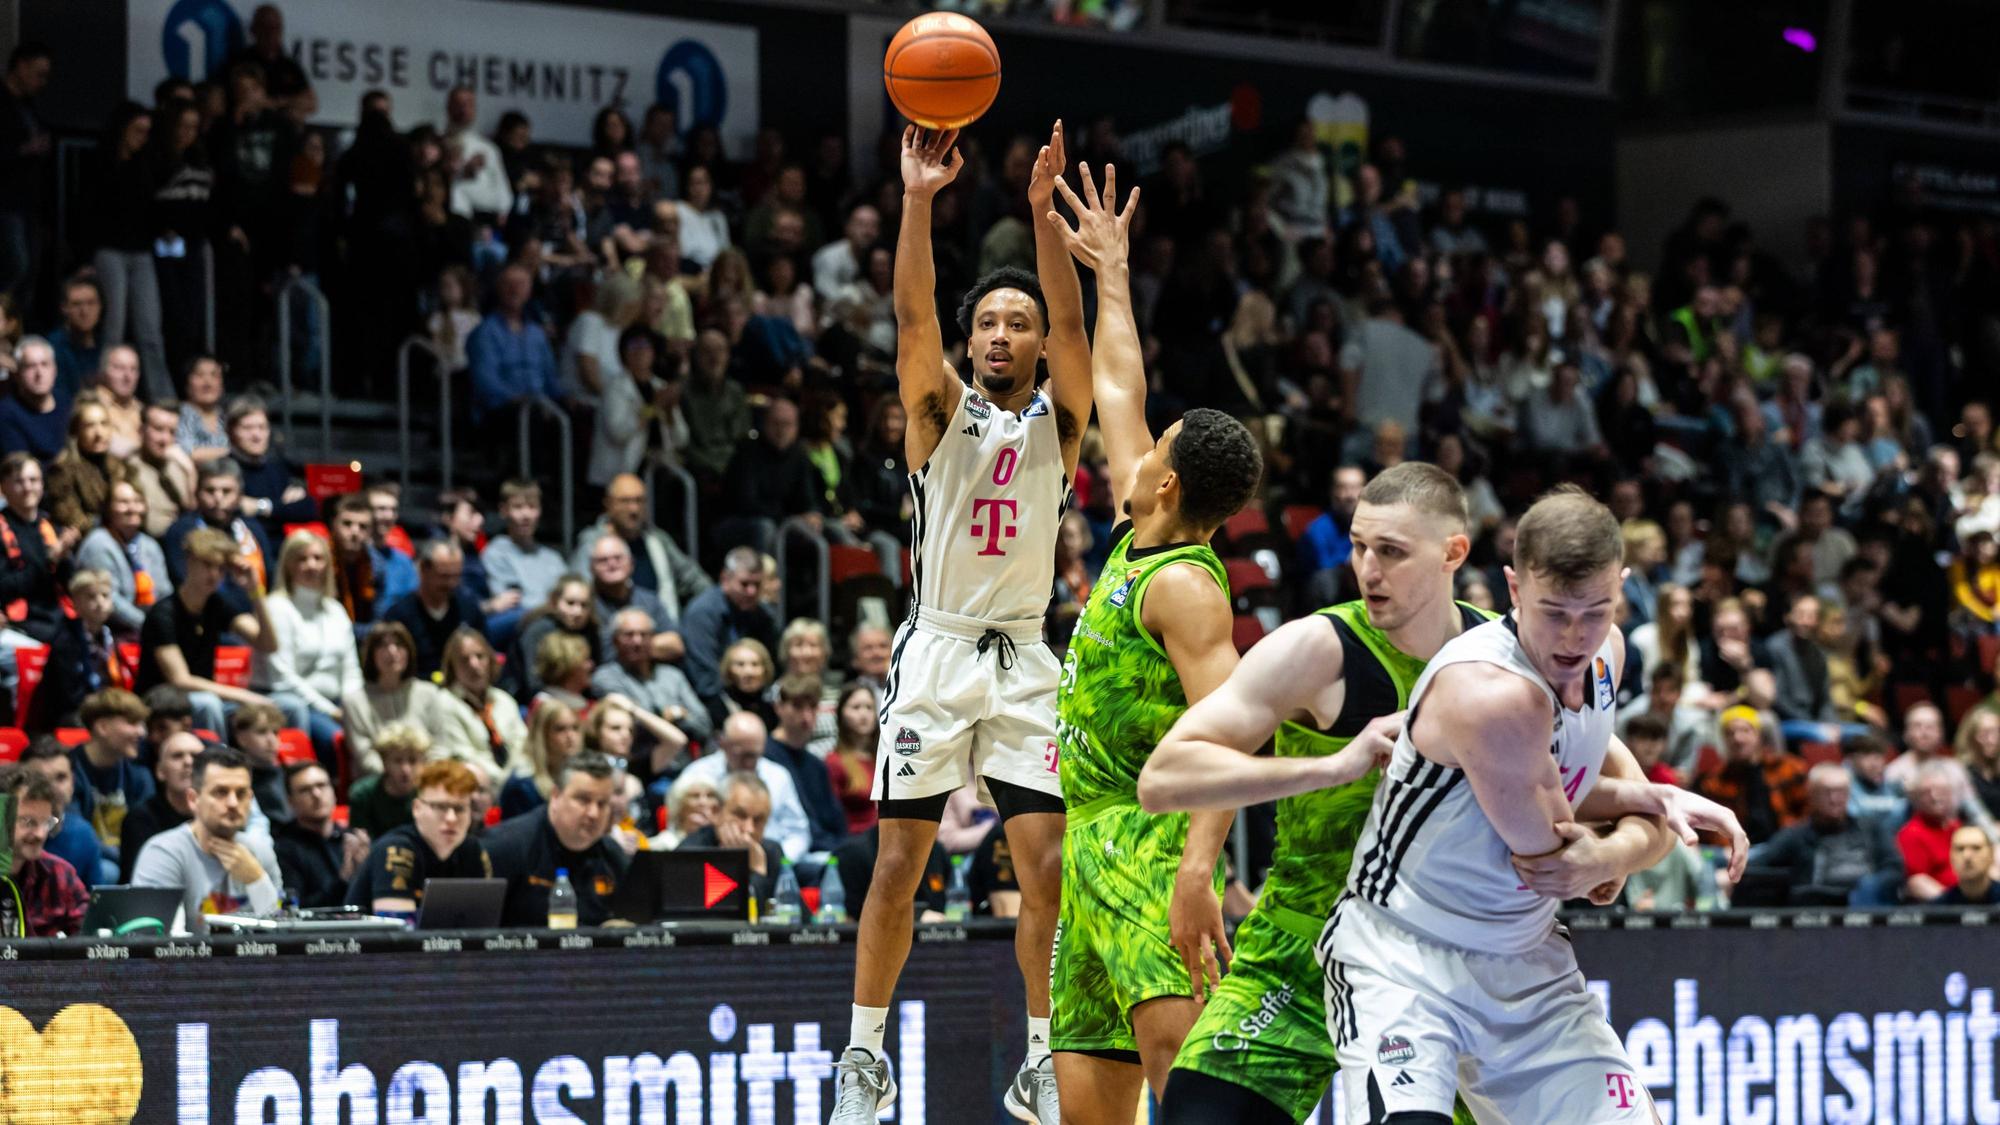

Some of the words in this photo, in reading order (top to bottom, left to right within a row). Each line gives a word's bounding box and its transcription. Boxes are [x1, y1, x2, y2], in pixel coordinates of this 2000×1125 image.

[291, 38, 409, 88] ESSE
[428, 51, 630, 110] CHEMNITZ
[966, 400, 990, 417] BASKETS
[992, 447, 1018, 486] 0
[971, 498, 1017, 556] T
[896, 742, 920, 750] BASKETS
[1379, 1046, 1414, 1063] BASKETS
[1586, 971, 2000, 1125] ebensmit
[1606, 1073, 1635, 1108] T
